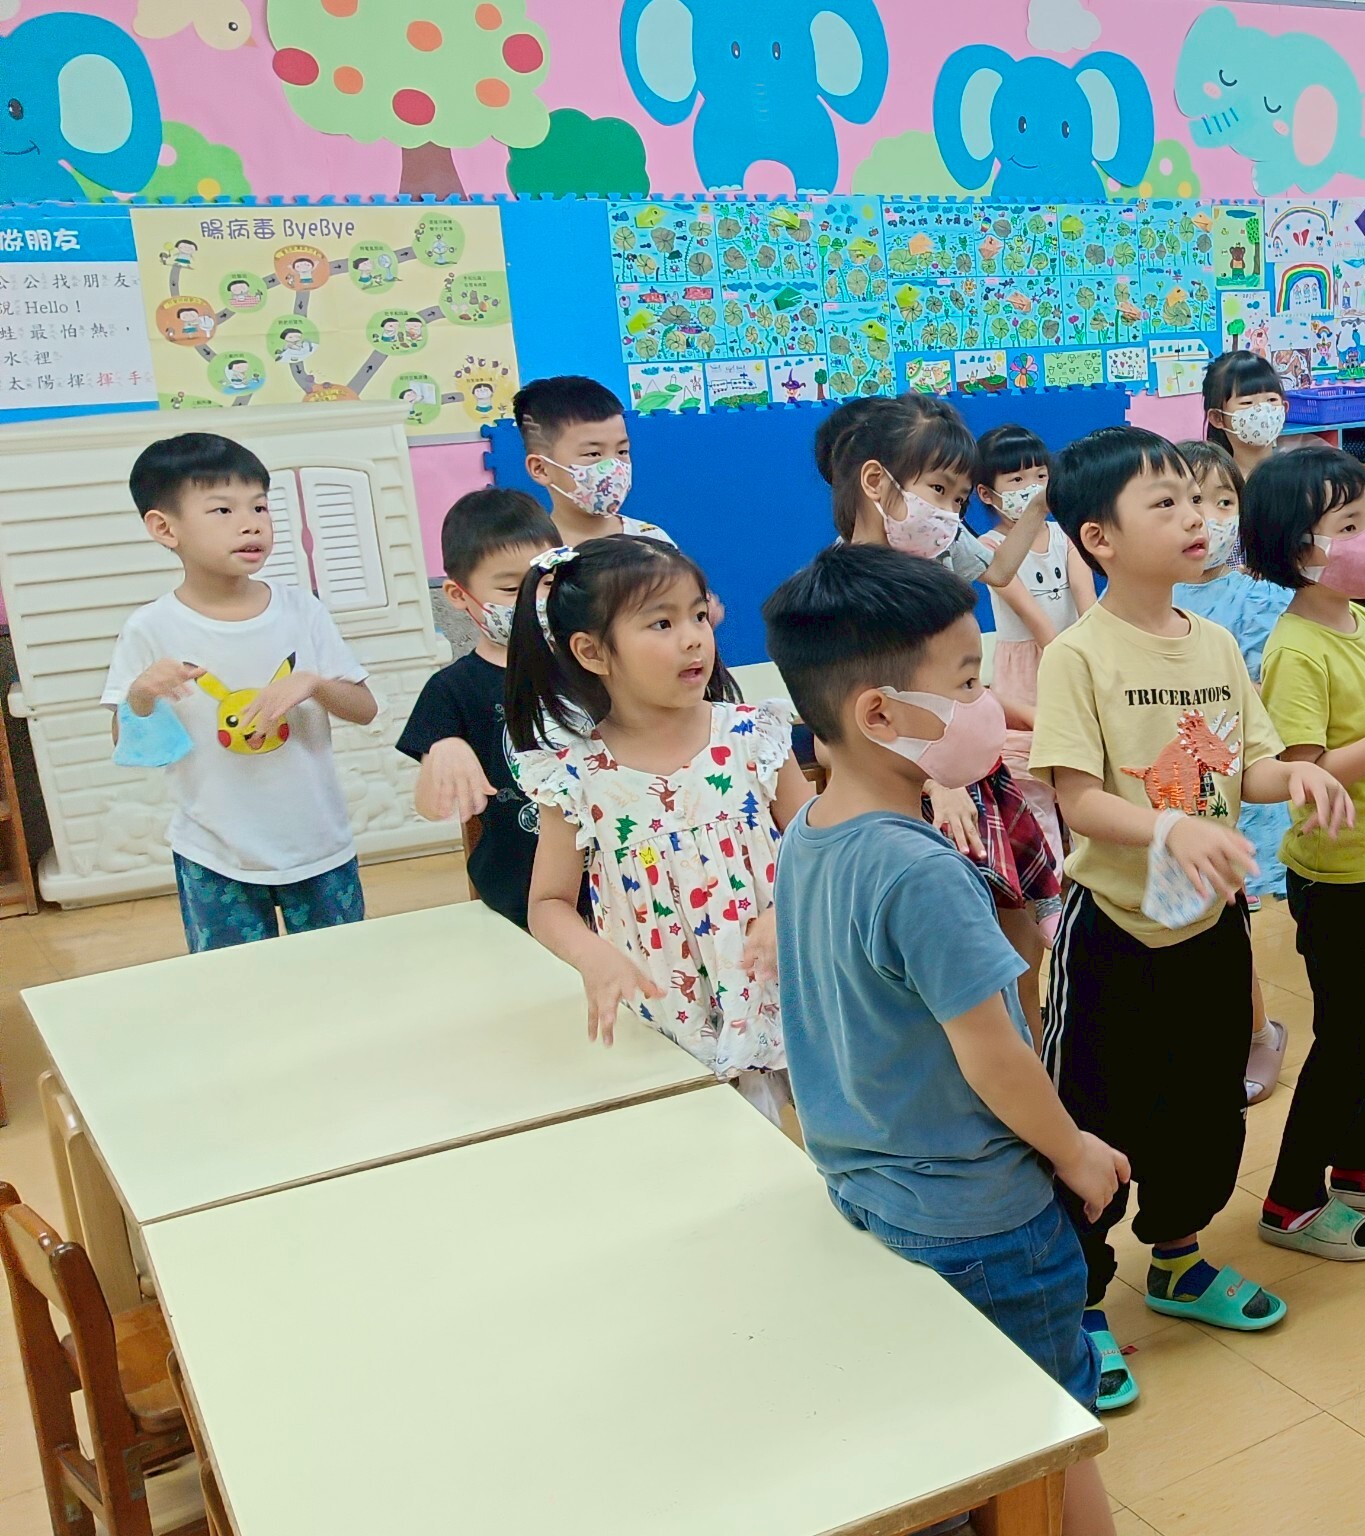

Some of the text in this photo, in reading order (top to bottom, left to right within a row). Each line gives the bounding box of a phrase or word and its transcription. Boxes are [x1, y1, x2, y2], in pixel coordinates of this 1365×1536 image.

[200, 218, 355, 240] 腸病毒 ByeBye
[1124, 685, 1231, 706] TRICERATOPS
